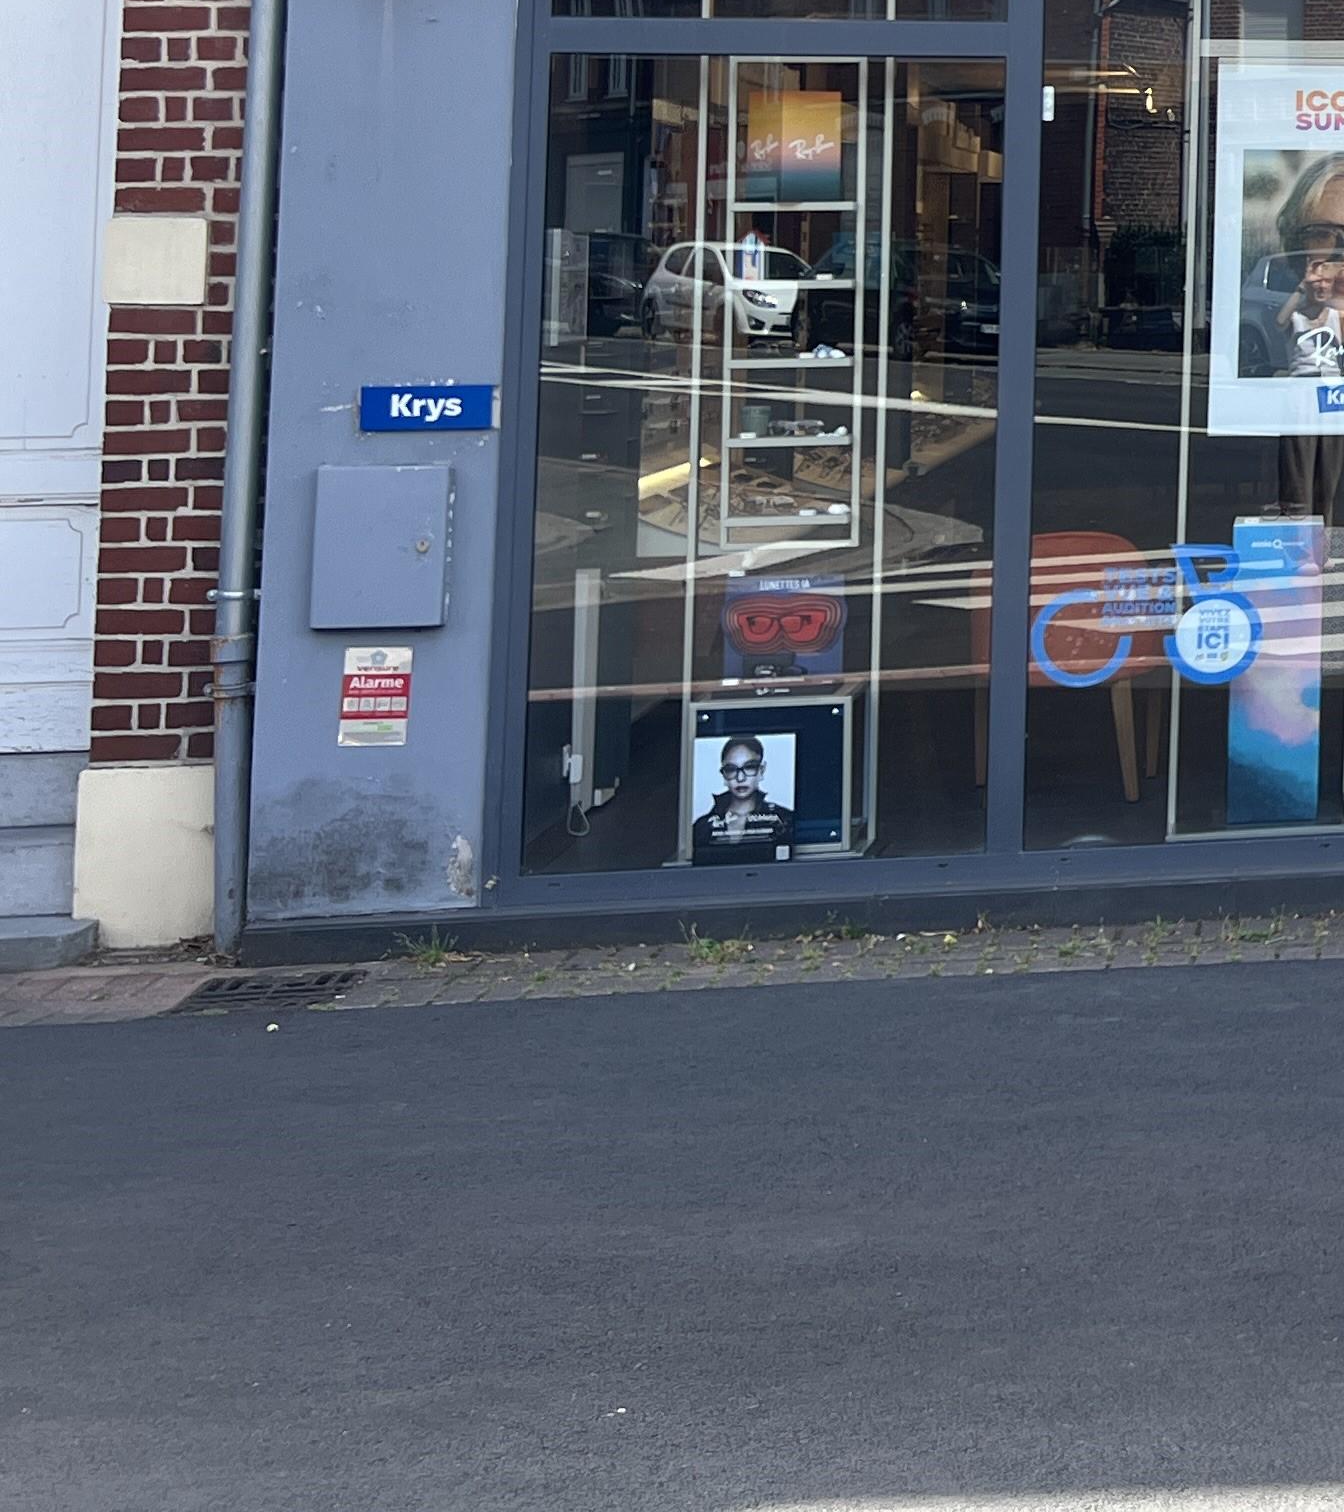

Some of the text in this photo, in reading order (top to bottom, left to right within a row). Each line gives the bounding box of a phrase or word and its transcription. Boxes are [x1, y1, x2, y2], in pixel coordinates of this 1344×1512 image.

[389, 392, 463, 423] Krys
[1103, 567, 1177, 584] TESTS
[1103, 601, 1177, 615] AUDITION
[1196, 632, 1230, 650] ICI
[349, 675, 405, 689] Alarme
